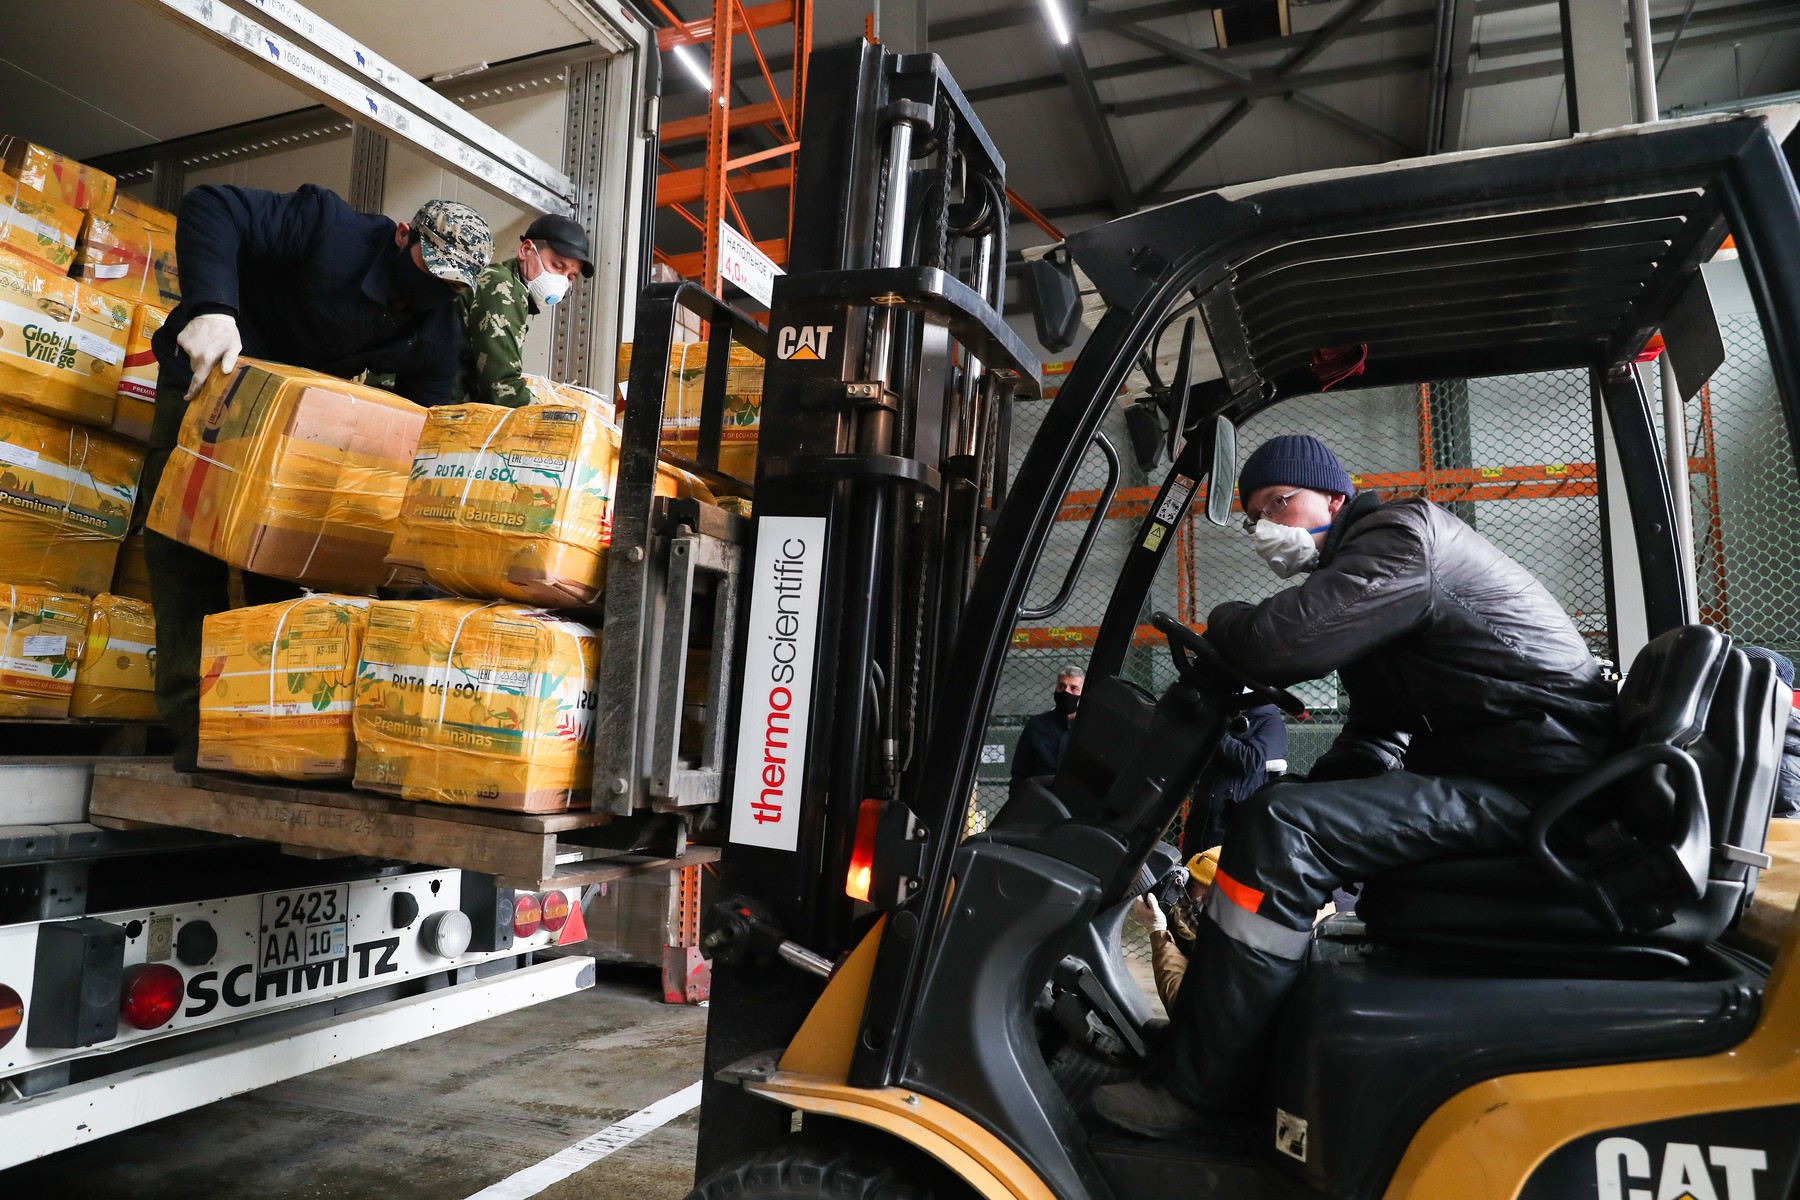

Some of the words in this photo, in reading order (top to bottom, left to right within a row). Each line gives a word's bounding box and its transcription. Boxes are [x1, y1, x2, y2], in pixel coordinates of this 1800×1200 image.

[283, 49, 301, 68] 1000
[302, 61, 317, 77] daN
[316, 69, 329, 85] (kg)
[726, 235, 767, 277] НАПОЛЬНОЕ
[777, 325, 833, 360] CAT
[132, 385, 155, 396] PREMIU
[434, 463, 465, 478] RUTA
[489, 467, 518, 484] SOL
[0, 489, 59, 515] Premium
[61, 506, 108, 529] Bananas
[465, 504, 525, 527] Bananas
[15, 678, 40, 688] PRODUCT
[391, 673, 425, 692] RUTA
[452, 683, 482, 701] SOL
[374, 715, 428, 737] Premium
[434, 727, 493, 747] ananas
[274, 889, 337, 929] 2423
[263, 931, 299, 969] AA
[308, 930, 331, 957] 10
[332, 943, 345, 954] UZ
[184, 936, 401, 1018] SCHMITZ
[1595, 1137, 1768, 1200] CAT
